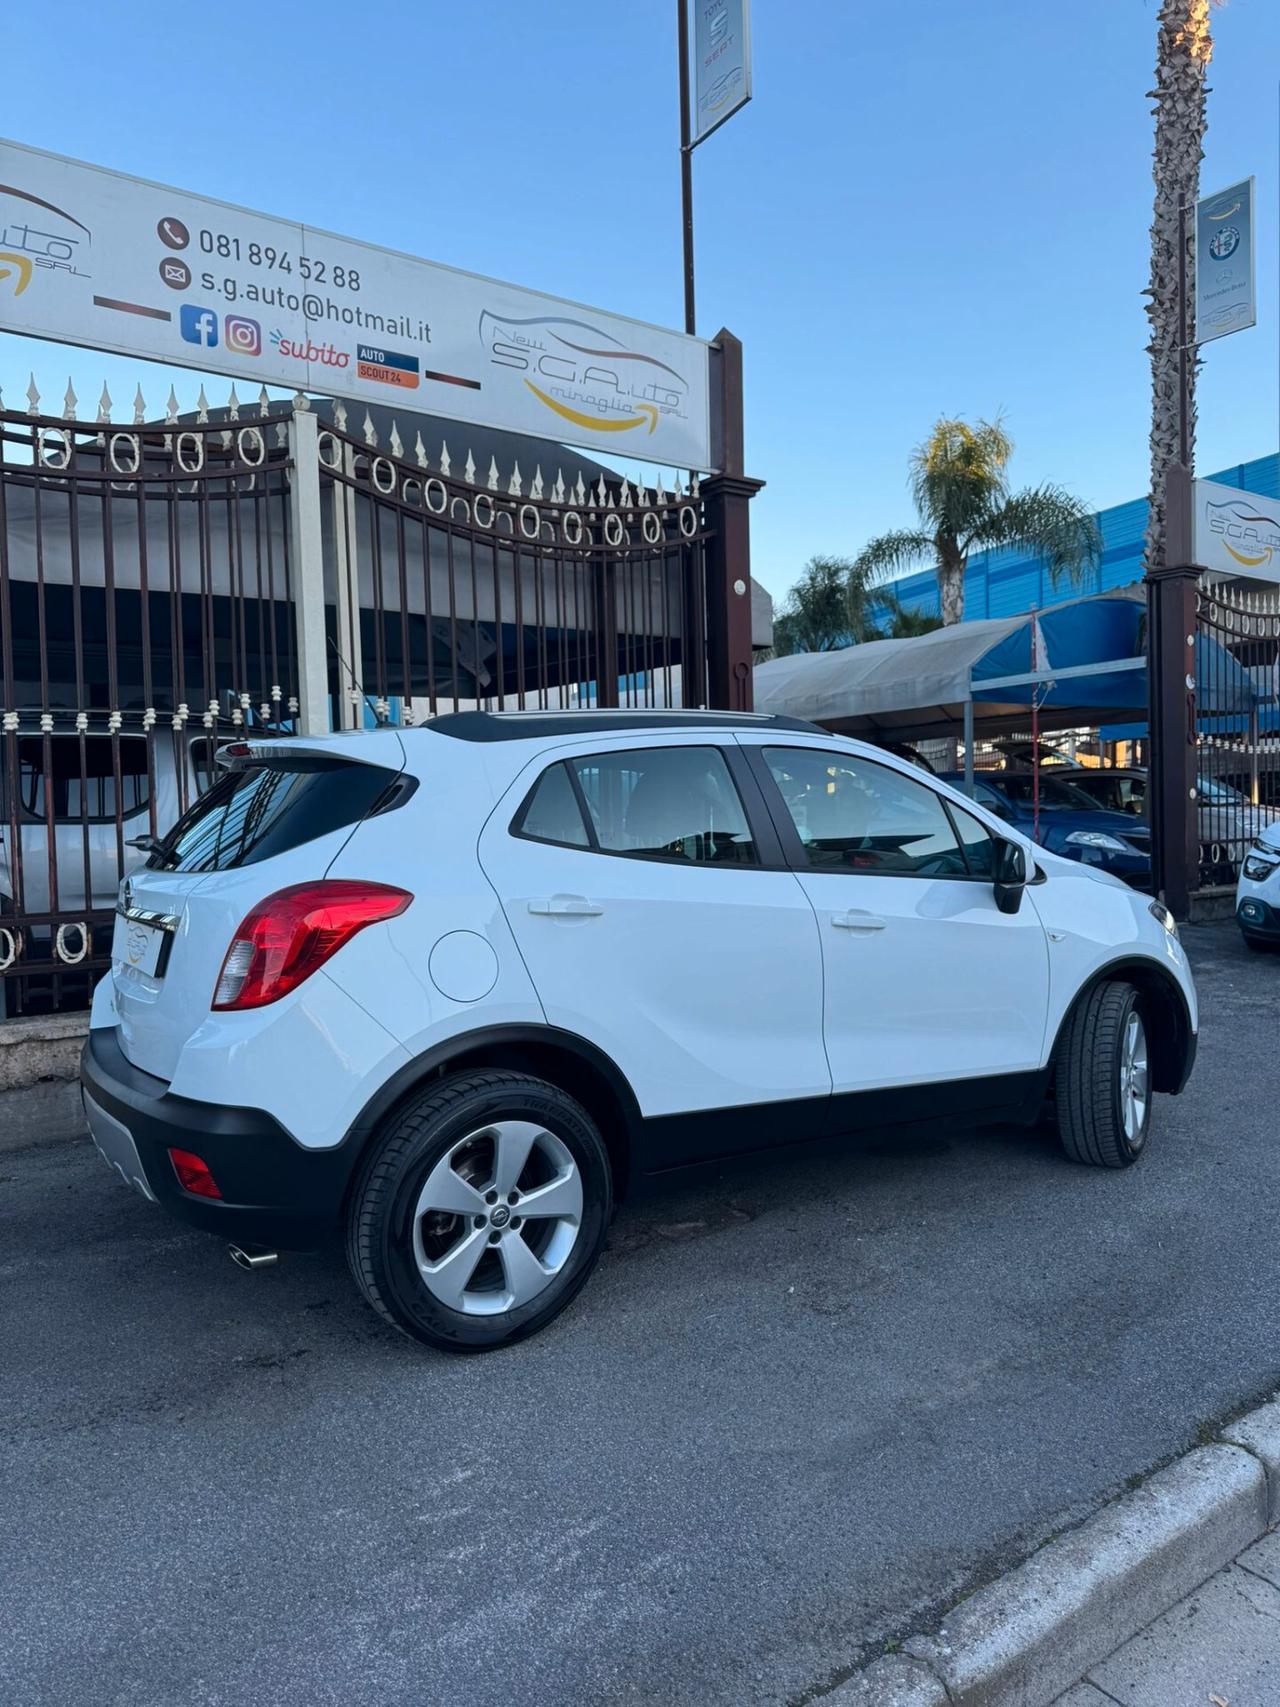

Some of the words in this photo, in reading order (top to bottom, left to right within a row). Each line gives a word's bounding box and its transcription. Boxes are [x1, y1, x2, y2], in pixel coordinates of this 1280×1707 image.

[200, 229, 241, 261] 081
[249, 243, 292, 274] 894
[299, 255, 327, 284] 52
[333, 265, 361, 292] 88
[201, 272, 432, 344] s.g.auto@hotmail.it
[279, 337, 350, 369] subito
[360, 348, 386, 364] AUTO
